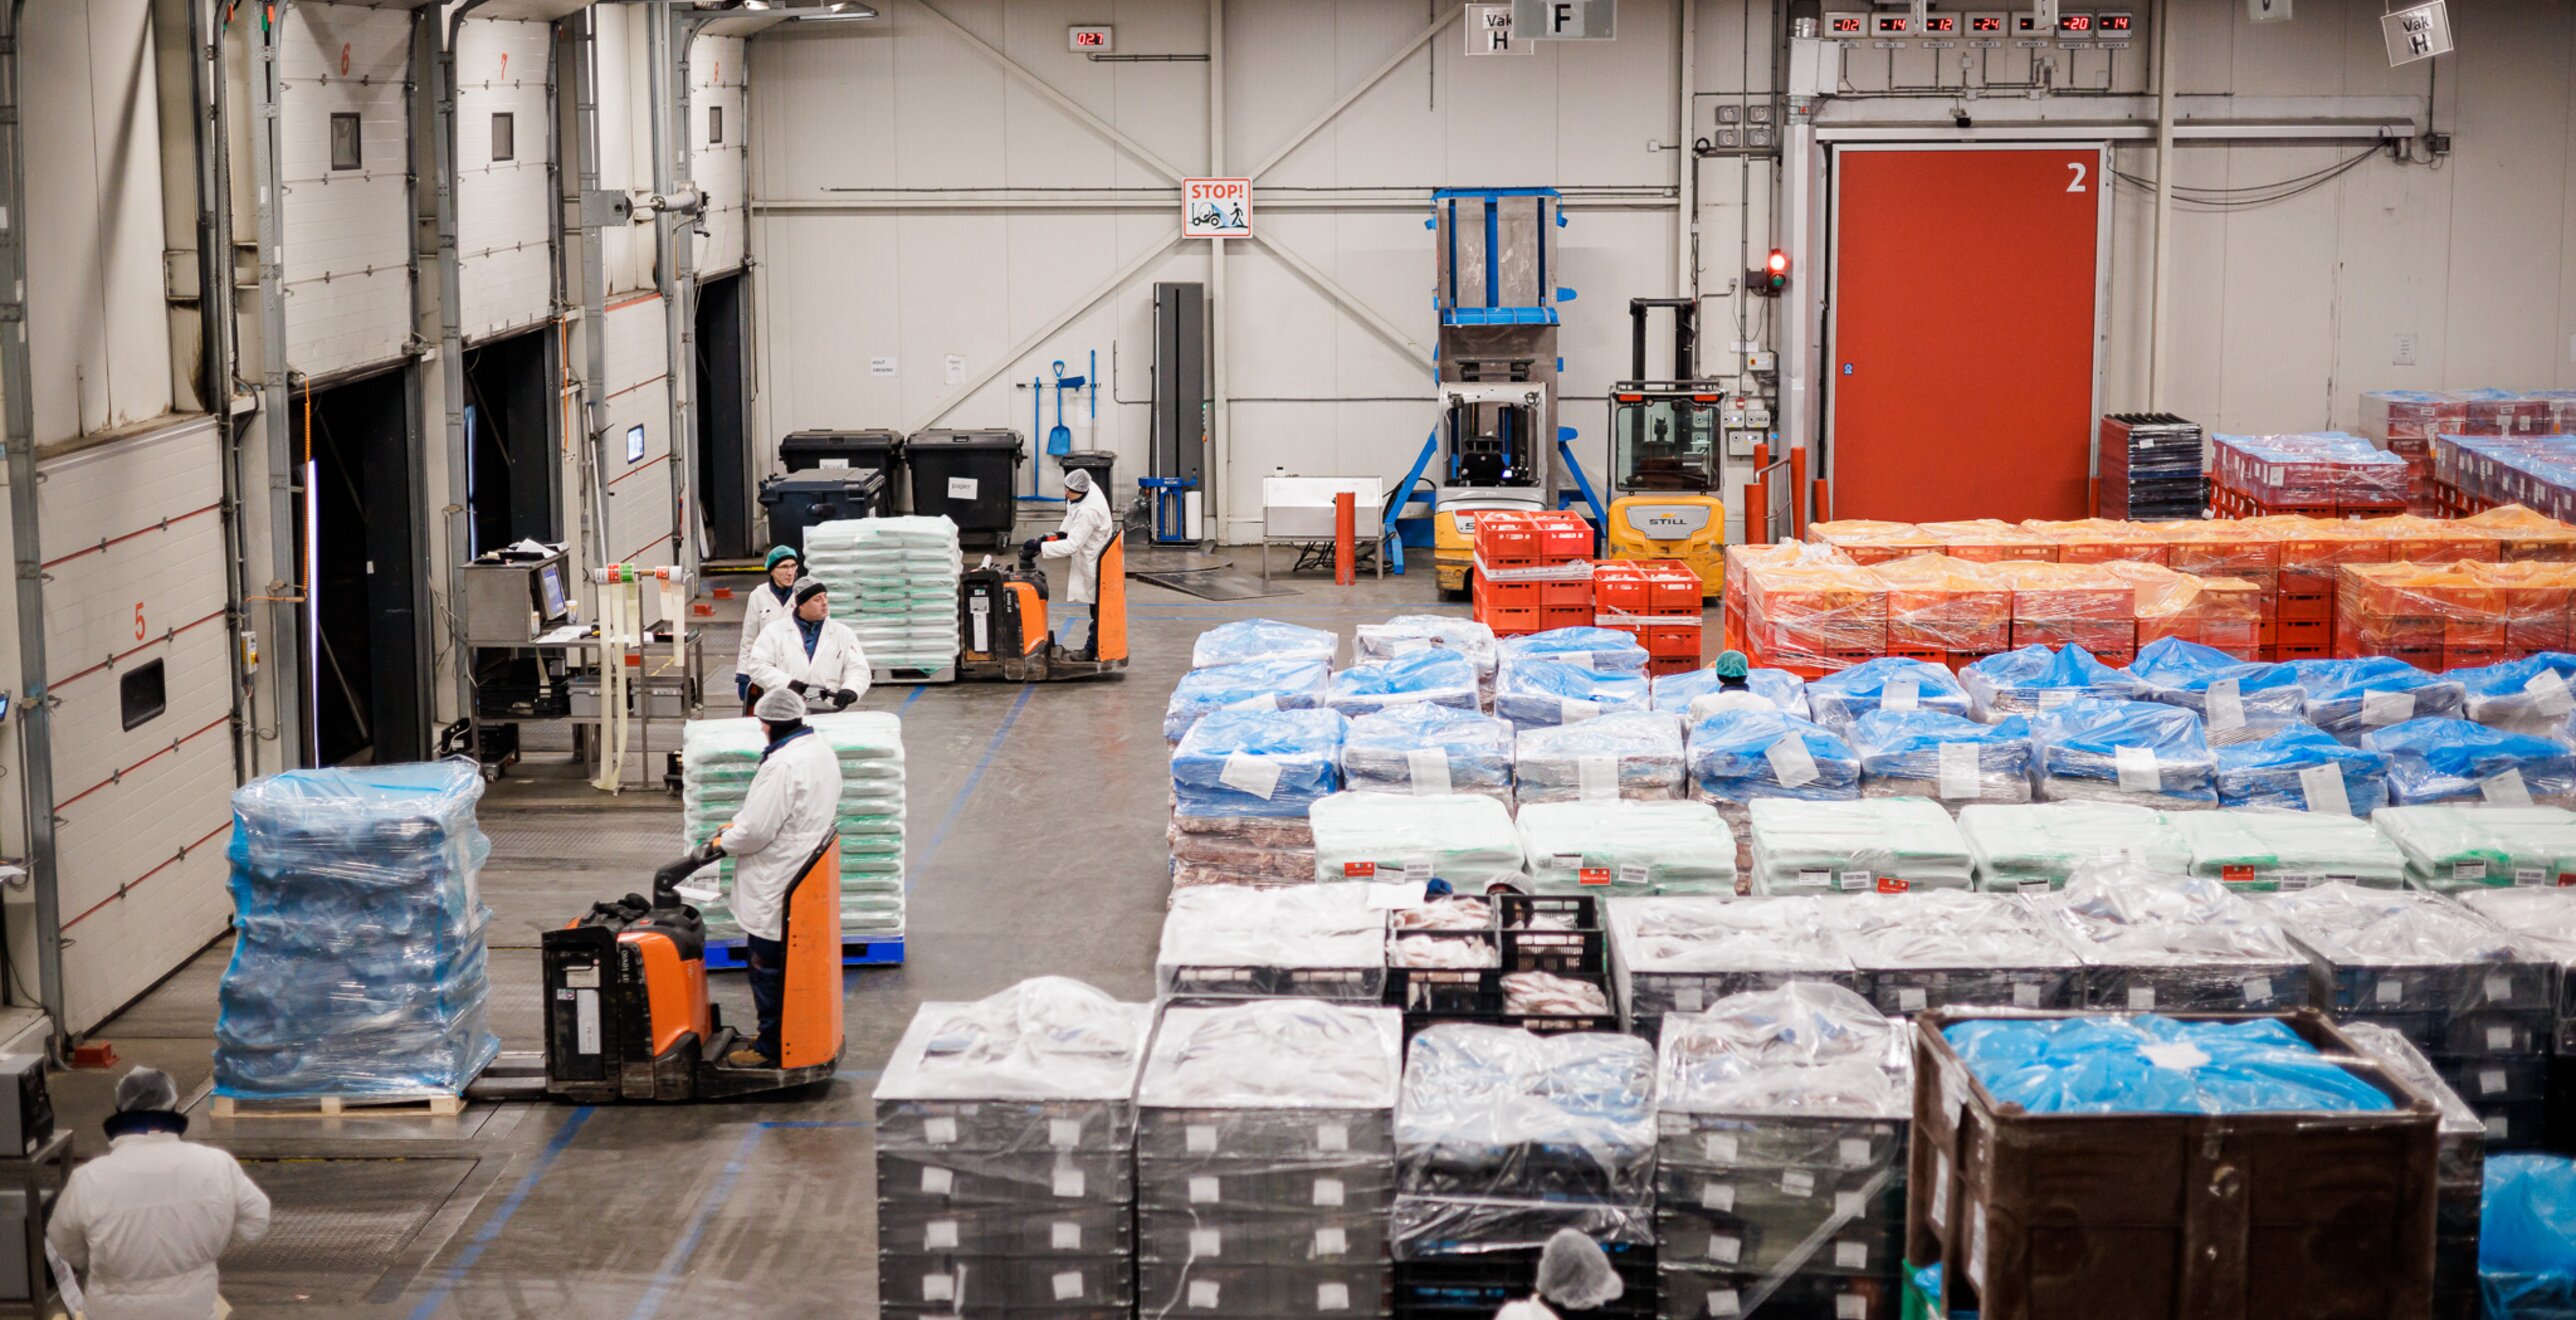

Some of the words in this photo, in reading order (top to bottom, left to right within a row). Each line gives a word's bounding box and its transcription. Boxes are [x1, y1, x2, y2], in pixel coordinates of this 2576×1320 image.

[1486, 14, 1512, 27] Vak
[1555, 4, 1571, 33] F
[1834, 19, 1860, 31] -02
[1927, 18, 1953, 31] -12
[1973, 18, 2000, 31] -24
[2063, 18, 2089, 30] -20
[2102, 18, 2128, 29] -14
[2402, 16, 2430, 32] Vak
[1493, 31, 1508, 50] H
[2412, 34, 2428, 55] H
[341, 42, 351, 77] 6
[501, 52, 508, 80] 7
[2066, 162, 2086, 192] 2
[1191, 184, 1243, 199] STOP!
[135, 602, 145, 641] 5
